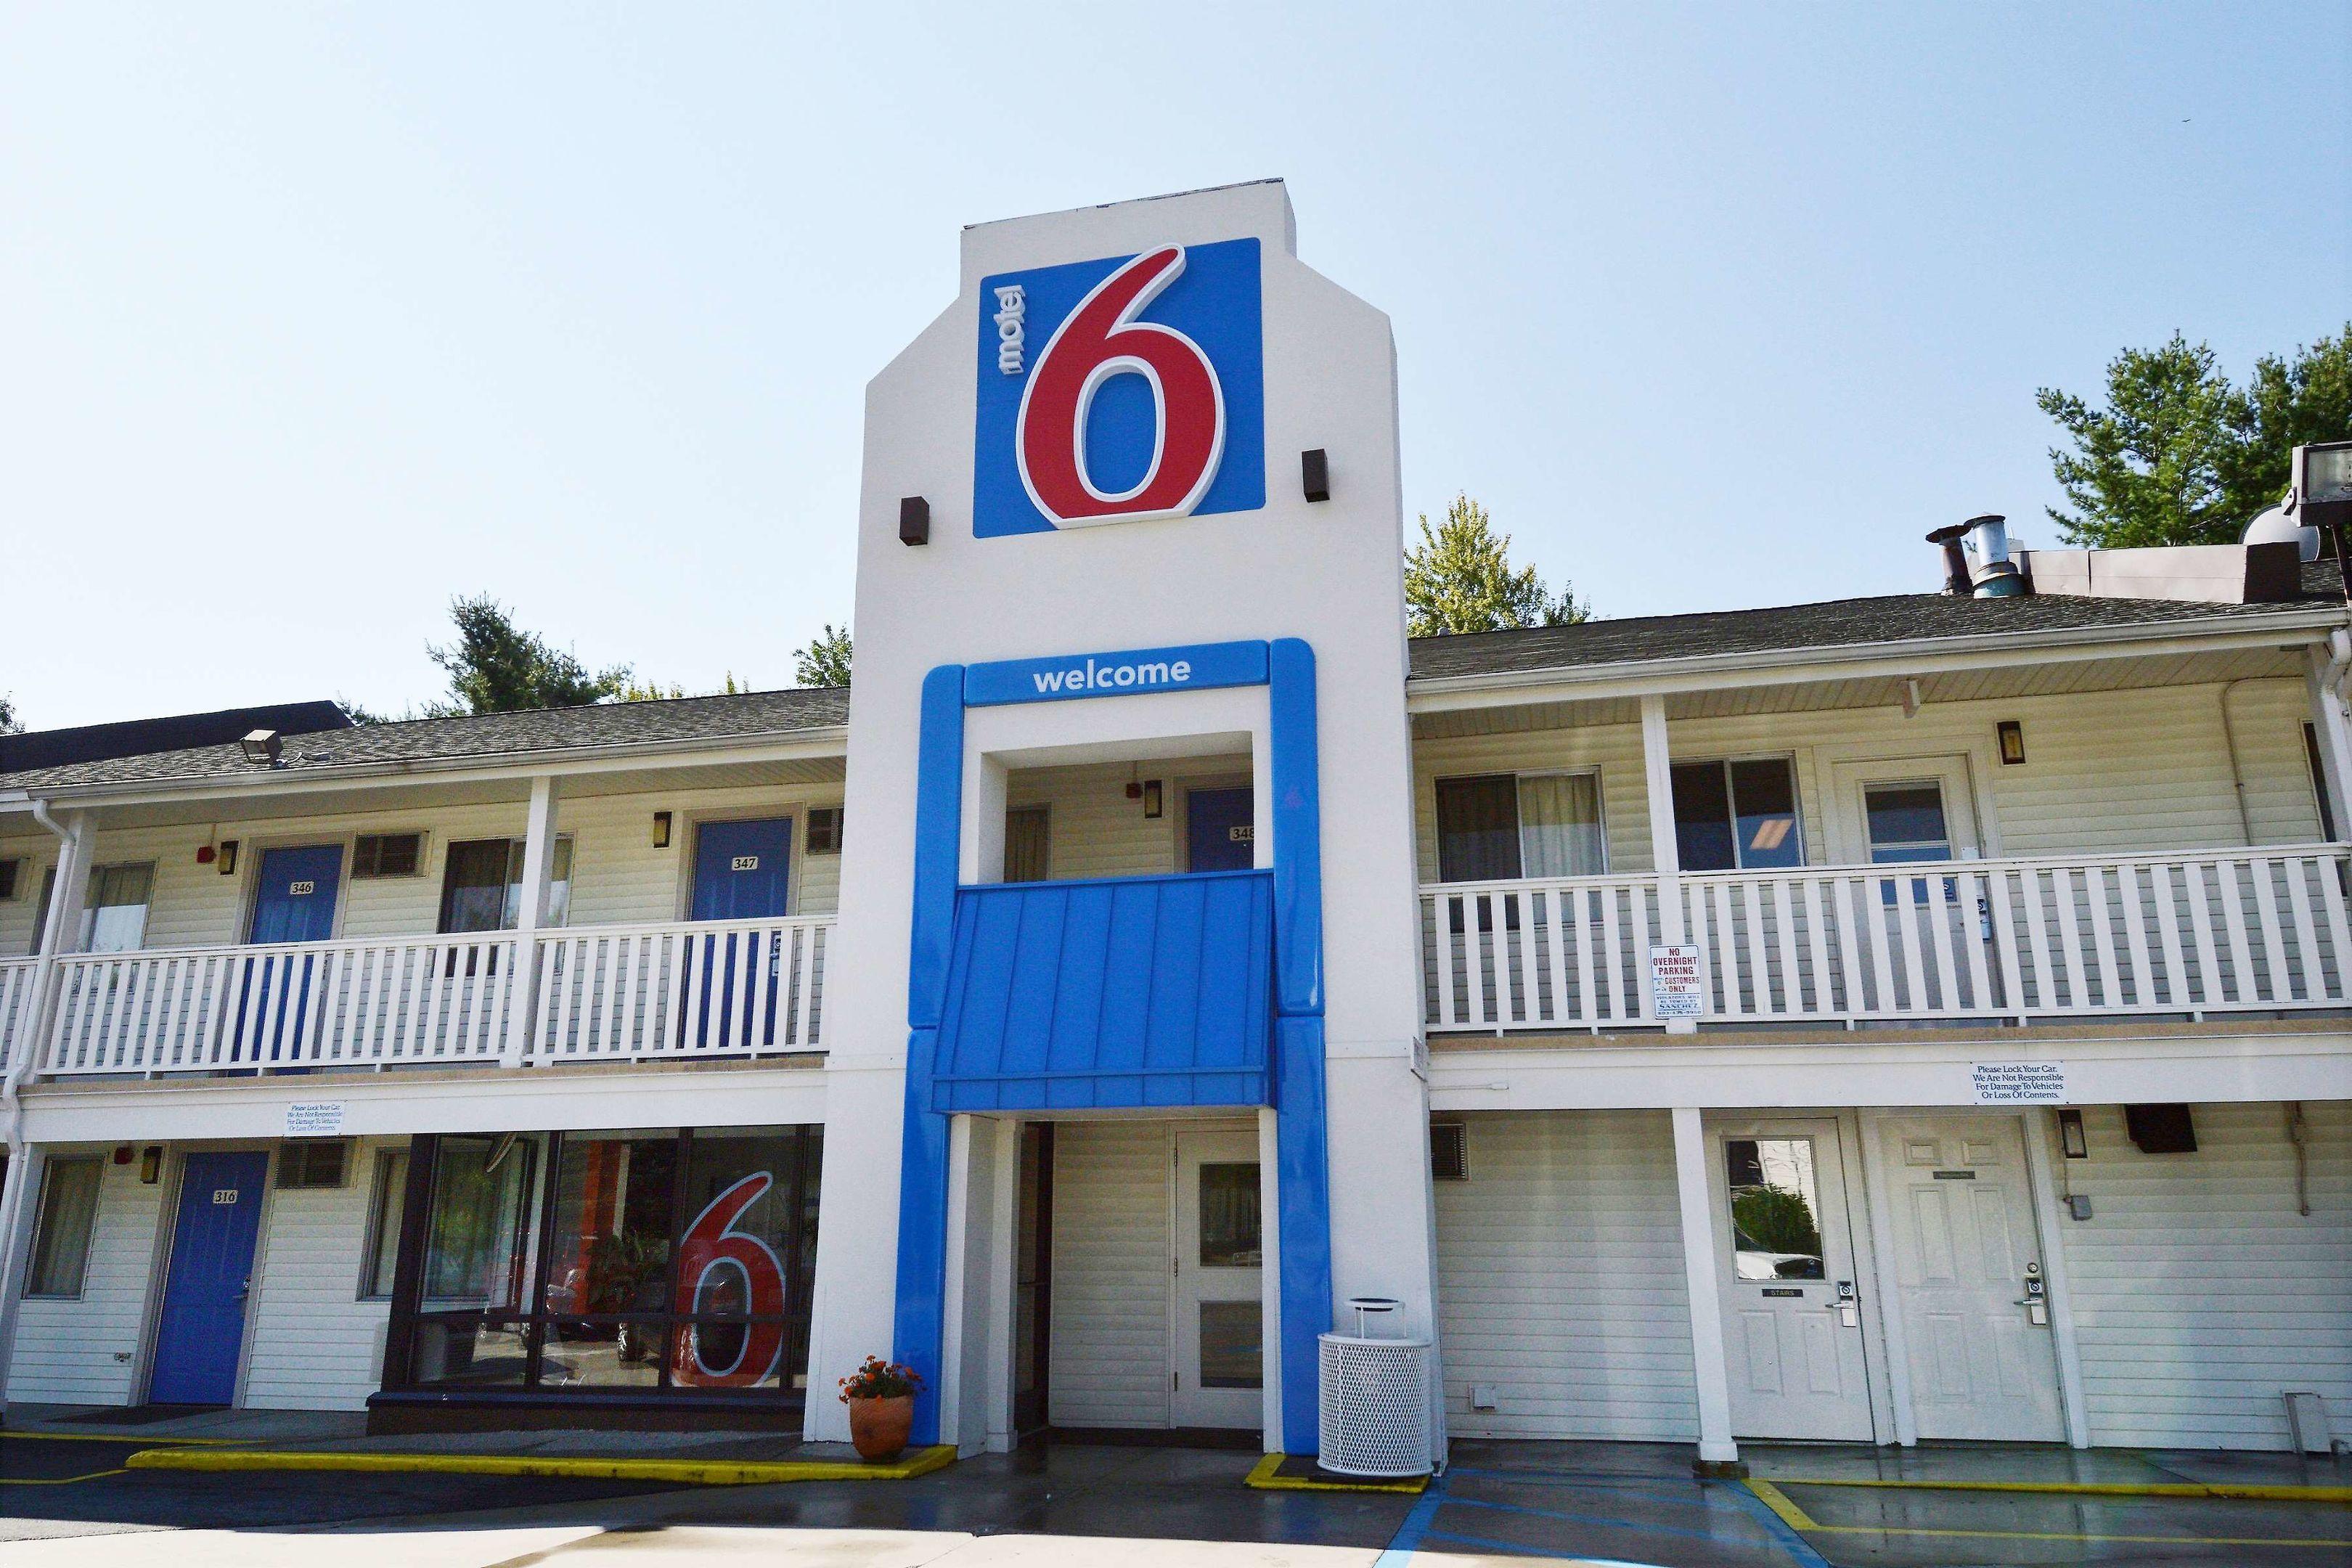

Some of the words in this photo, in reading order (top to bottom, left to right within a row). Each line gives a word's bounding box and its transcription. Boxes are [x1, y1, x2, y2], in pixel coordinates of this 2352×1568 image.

[994, 284, 1026, 375] motel
[1016, 242, 1228, 531] 6
[1033, 659, 1191, 693] welcome
[734, 858, 756, 869] 347
[292, 883, 311, 893] 346
[1653, 957, 1697, 965] OVERNIGHT
[1658, 966, 1694, 975] PARKING
[2018, 1074, 2064, 1082] Responsible
[1990, 1082, 2021, 1091] Damage
[216, 1191, 235, 1202] 316
[672, 1171, 786, 1387] 6
